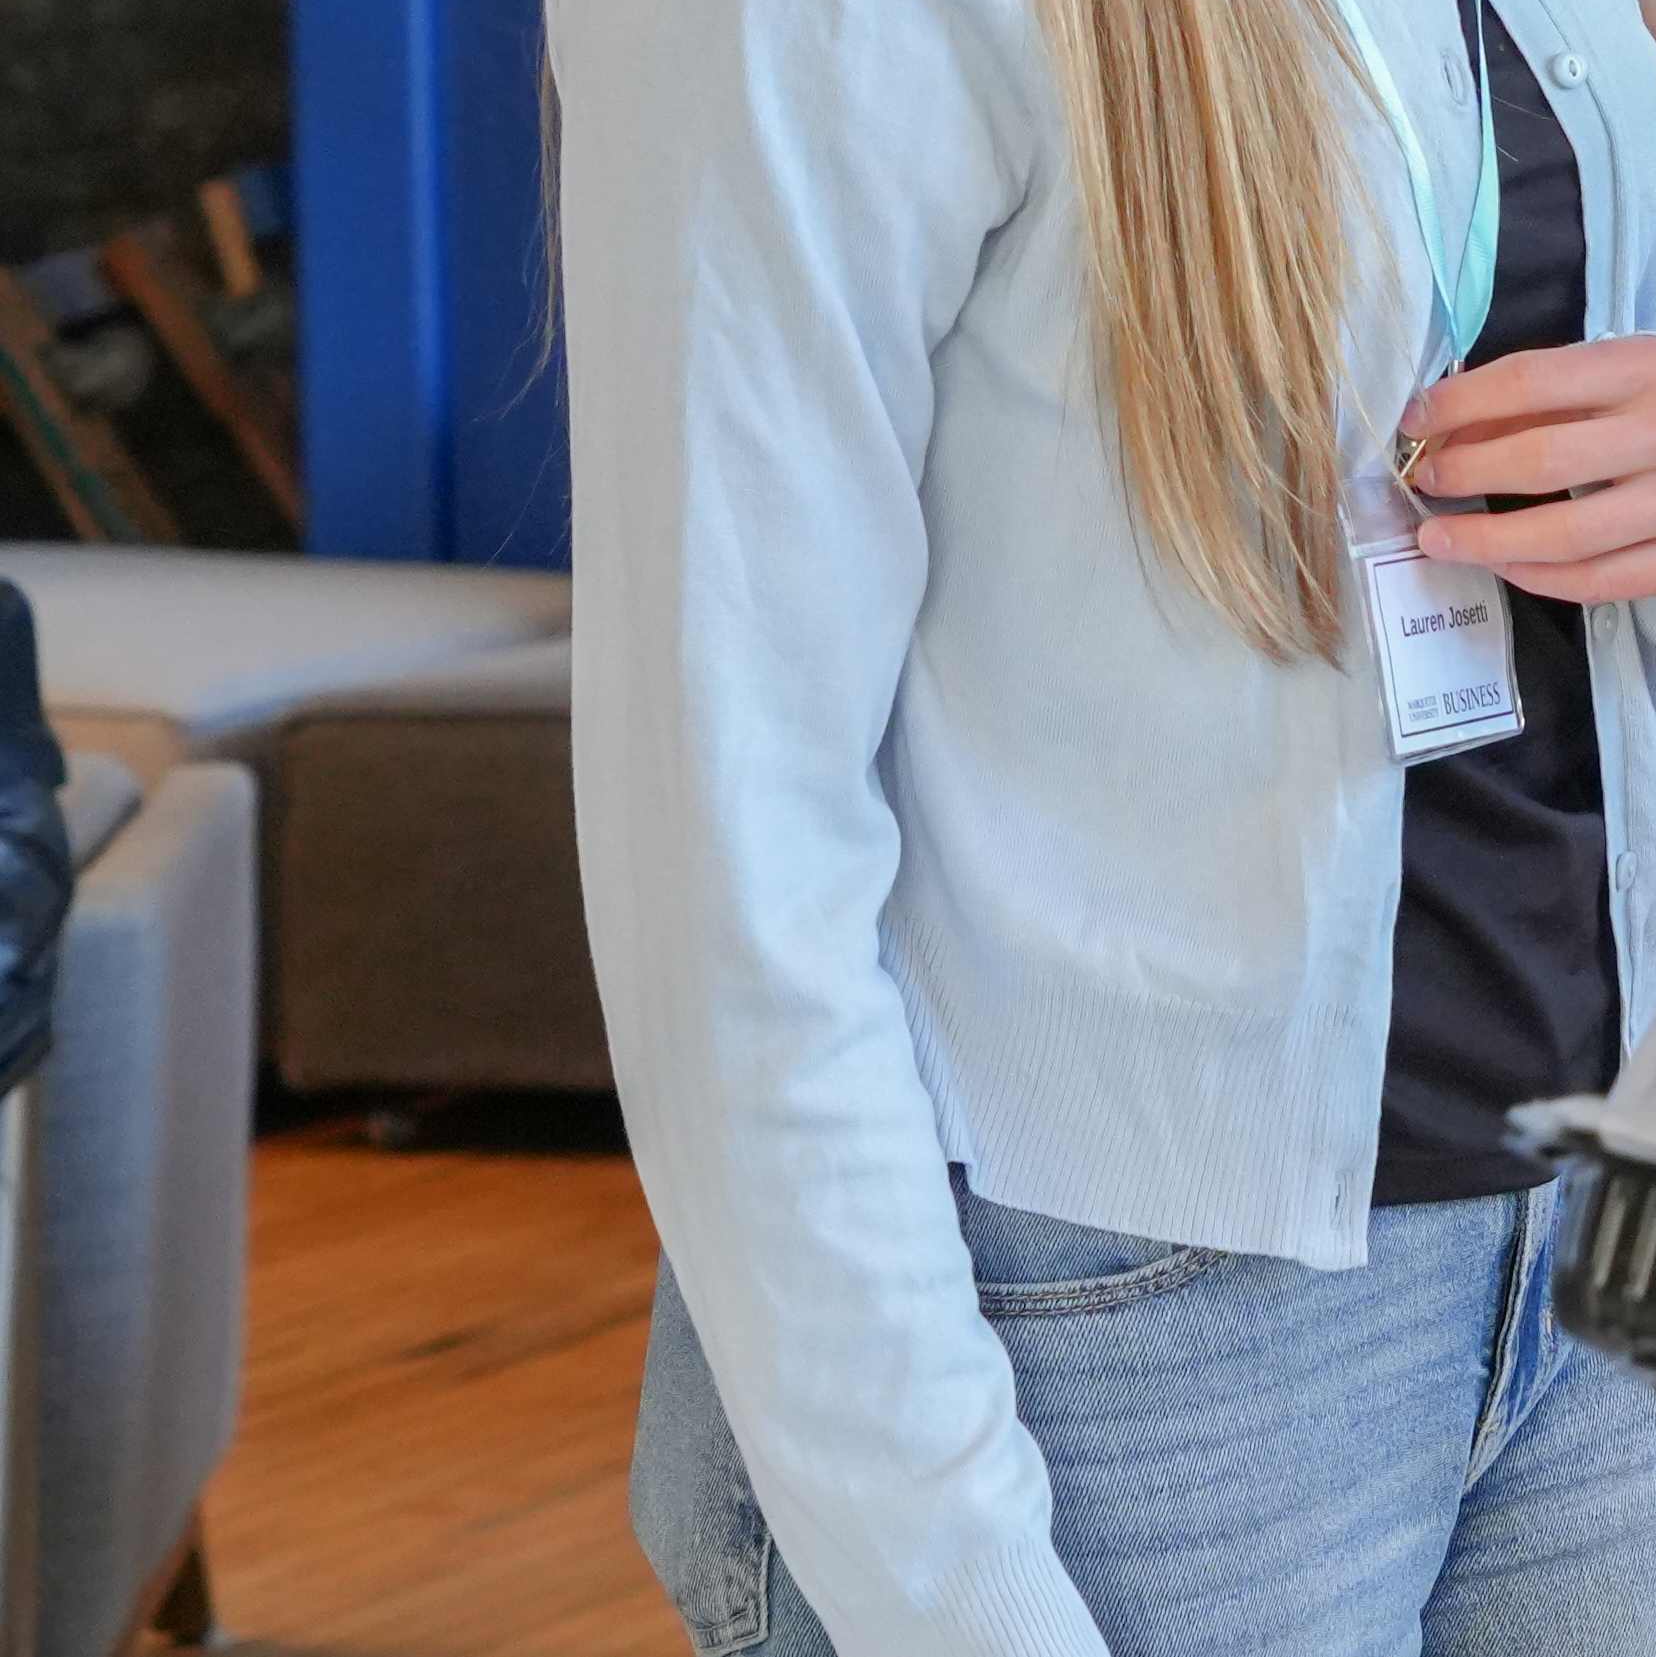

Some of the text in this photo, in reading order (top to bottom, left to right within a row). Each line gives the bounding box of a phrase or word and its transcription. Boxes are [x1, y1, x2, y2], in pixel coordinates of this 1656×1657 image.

[1400, 599, 1489, 637] Lauren Josetti
[1442, 682, 1502, 715] BUSINESS
